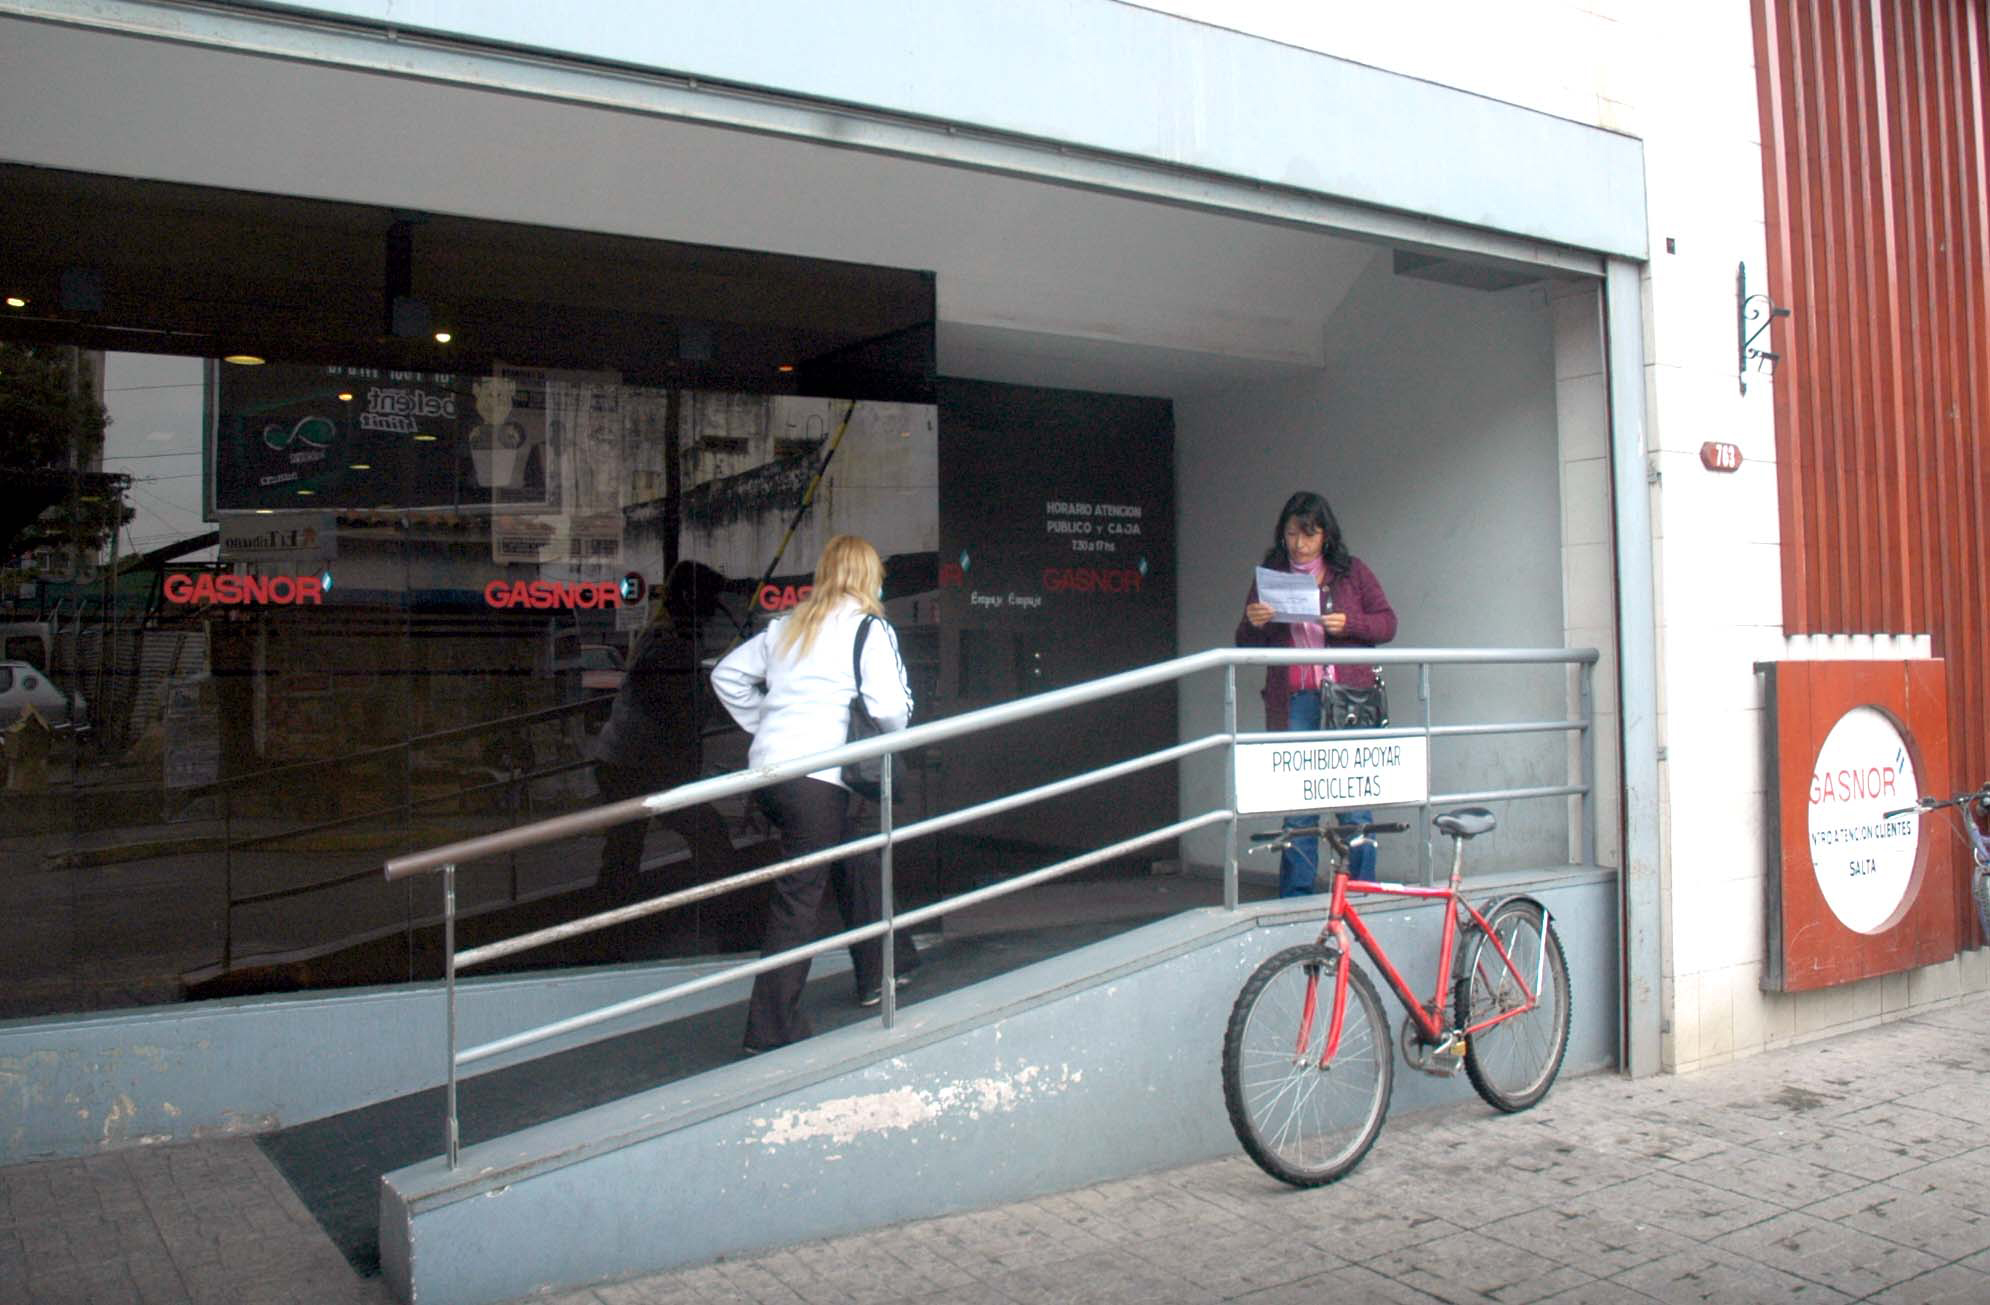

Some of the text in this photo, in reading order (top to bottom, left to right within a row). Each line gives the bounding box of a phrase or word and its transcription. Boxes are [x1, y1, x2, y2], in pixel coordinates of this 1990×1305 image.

[1046, 501, 1142, 518] HORARIO ATENCION
[1047, 520, 1092, 534] PUBLICO
[1107, 523, 1141, 535] CAJA
[163, 573, 323, 605] GASNOR
[1042, 566, 1142, 593] GASNOR
[484, 579, 622, 609] GASNOR
[1272, 745, 1401, 773] PROHIBIDO APOYAR
[1303, 775, 1382, 801] BICICLETAS
[1809, 766, 1896, 805] GASNOR
[1875, 820, 1911, 839] CLIENTES
[1849, 858, 1876, 877] SALTA
